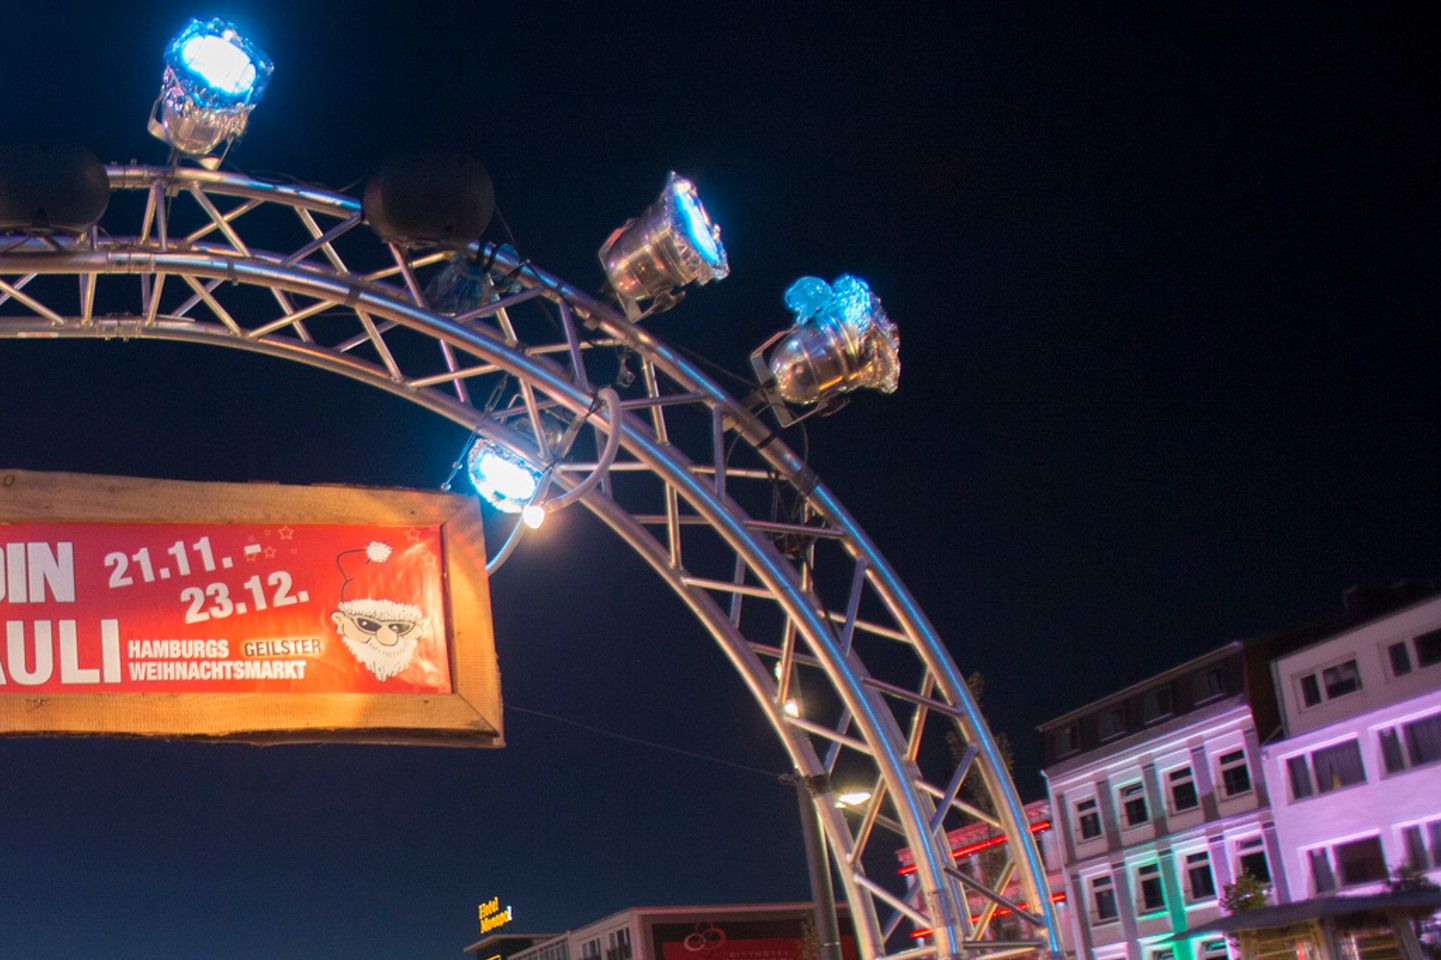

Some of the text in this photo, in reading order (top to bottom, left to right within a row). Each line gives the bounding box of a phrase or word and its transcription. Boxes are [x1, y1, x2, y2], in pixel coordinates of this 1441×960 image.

[104, 536, 234, 588] 21.11.
[180, 570, 310, 624] 23.12.
[128, 639, 322, 659] HAMBURGS GEILSTER
[129, 660, 306, 681] WEIHNACHTSMARKT
